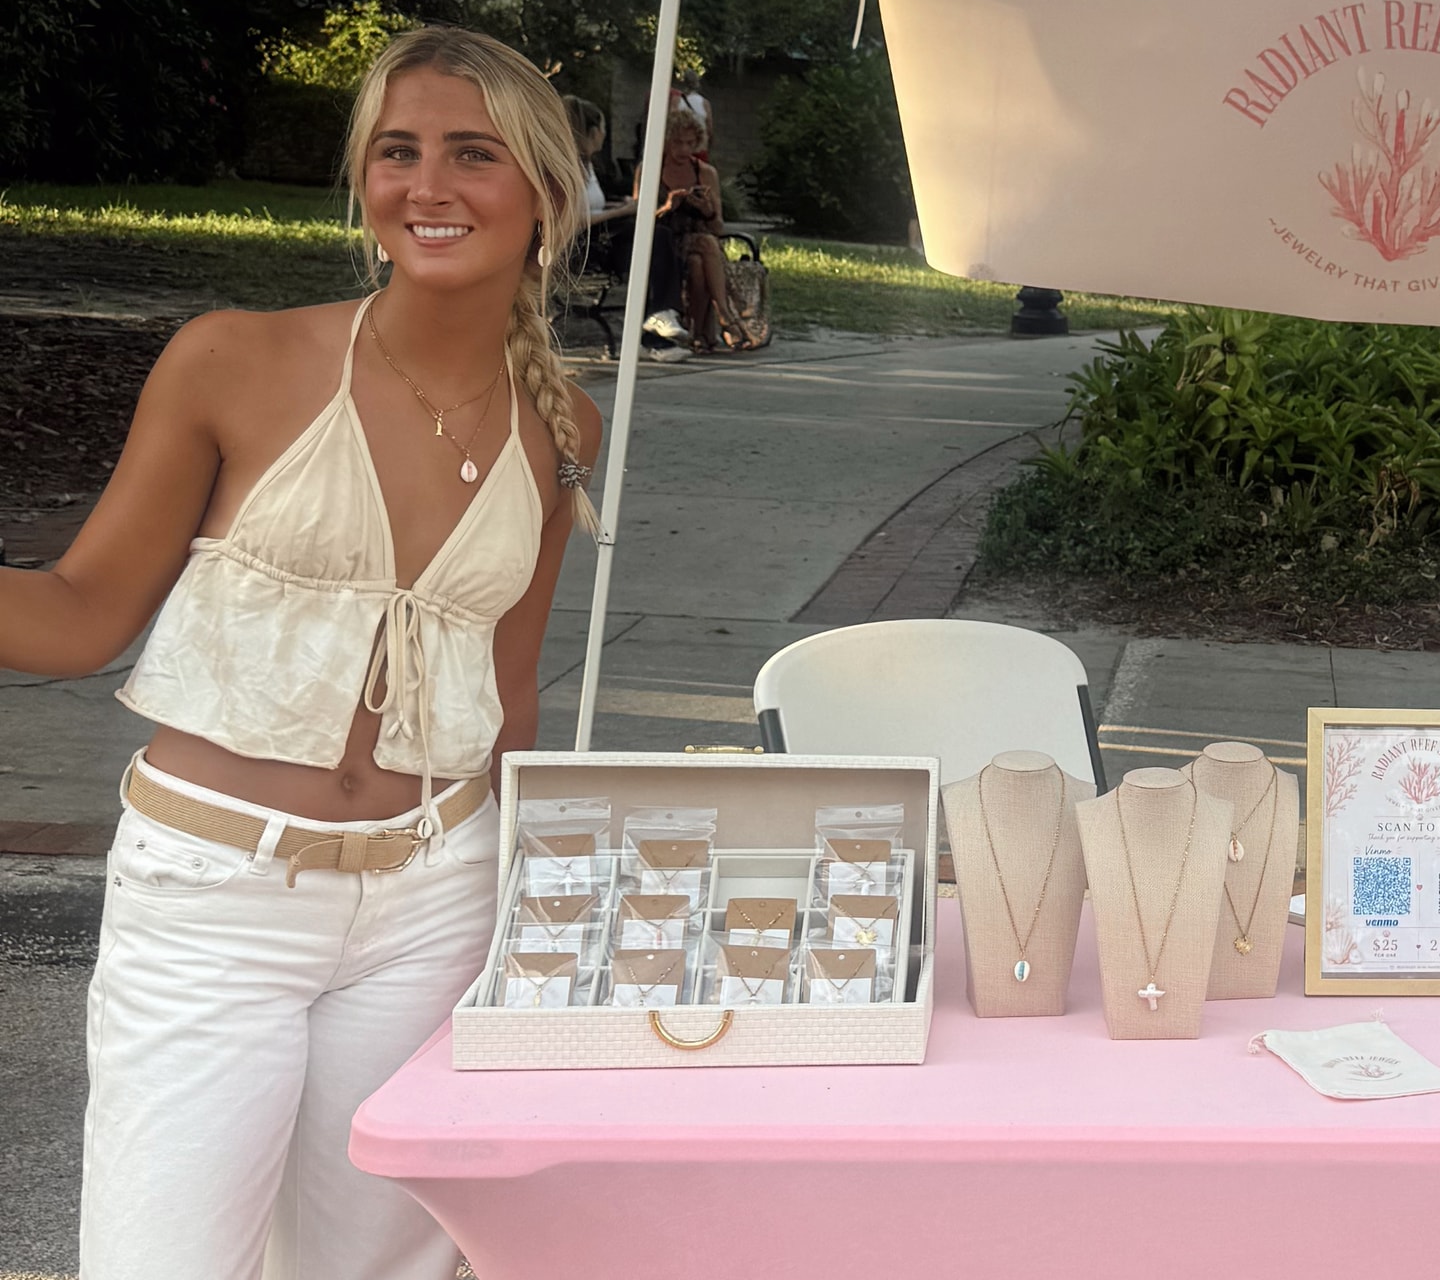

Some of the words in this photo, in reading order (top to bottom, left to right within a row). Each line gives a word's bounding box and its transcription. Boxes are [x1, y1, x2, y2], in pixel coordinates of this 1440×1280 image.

[1222, 2, 1371, 129] RADIANT
[1353, 273, 1400, 293] THAT
[1371, 741, 1408, 780] RADIANT
[1410, 738, 1438, 752] REEF
[1377, 822, 1411, 832] SCAN
[1417, 822, 1435, 832] TO
[1365, 845, 1392, 855] Venmo
[1365, 919, 1399, 927] venmo
[1373, 939, 1398, 951] $25
[1430, 940, 1438, 951] 2
